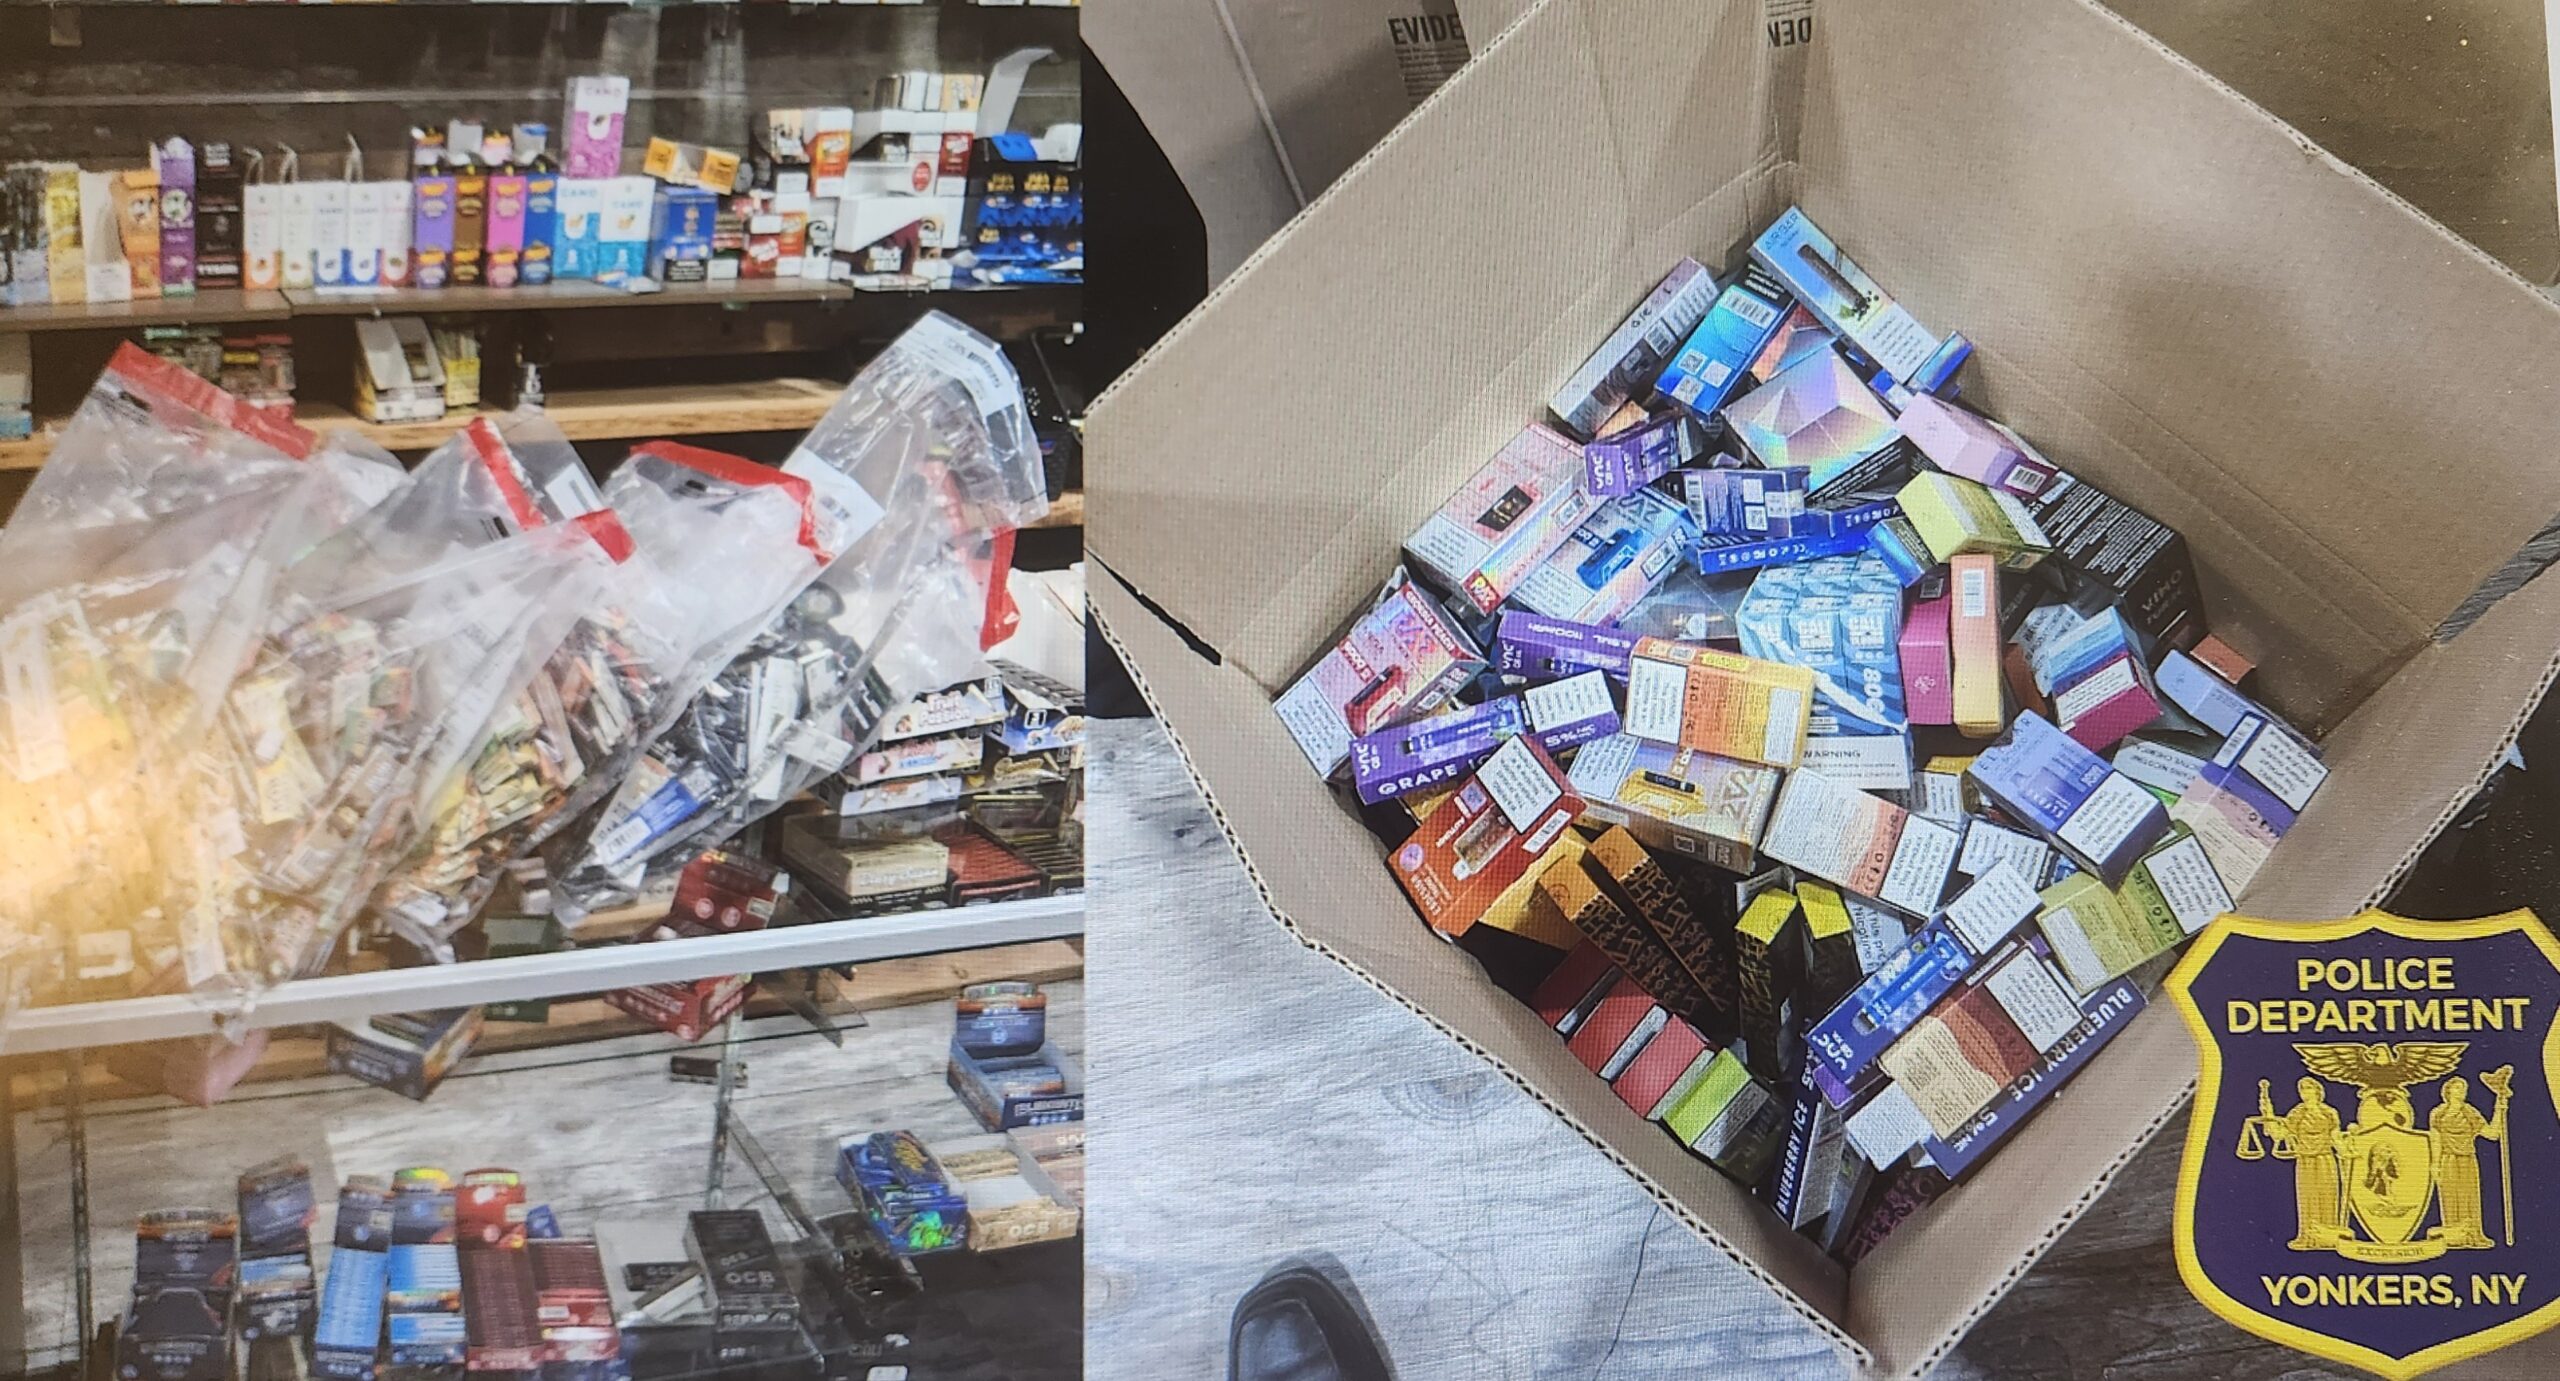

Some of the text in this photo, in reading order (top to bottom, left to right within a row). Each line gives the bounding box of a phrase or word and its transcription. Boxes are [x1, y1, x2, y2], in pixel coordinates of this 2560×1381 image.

[1803, 749, 1860, 758] WARNING
[1378, 763, 1458, 795] GRAPE
[2043, 986, 2134, 1073] BLUEBERRY
[2007, 1070, 2045, 1102] ICE
[1775, 1124, 1803, 1215] BLUEBERRY
[725, 1269, 775, 1286] OCB
